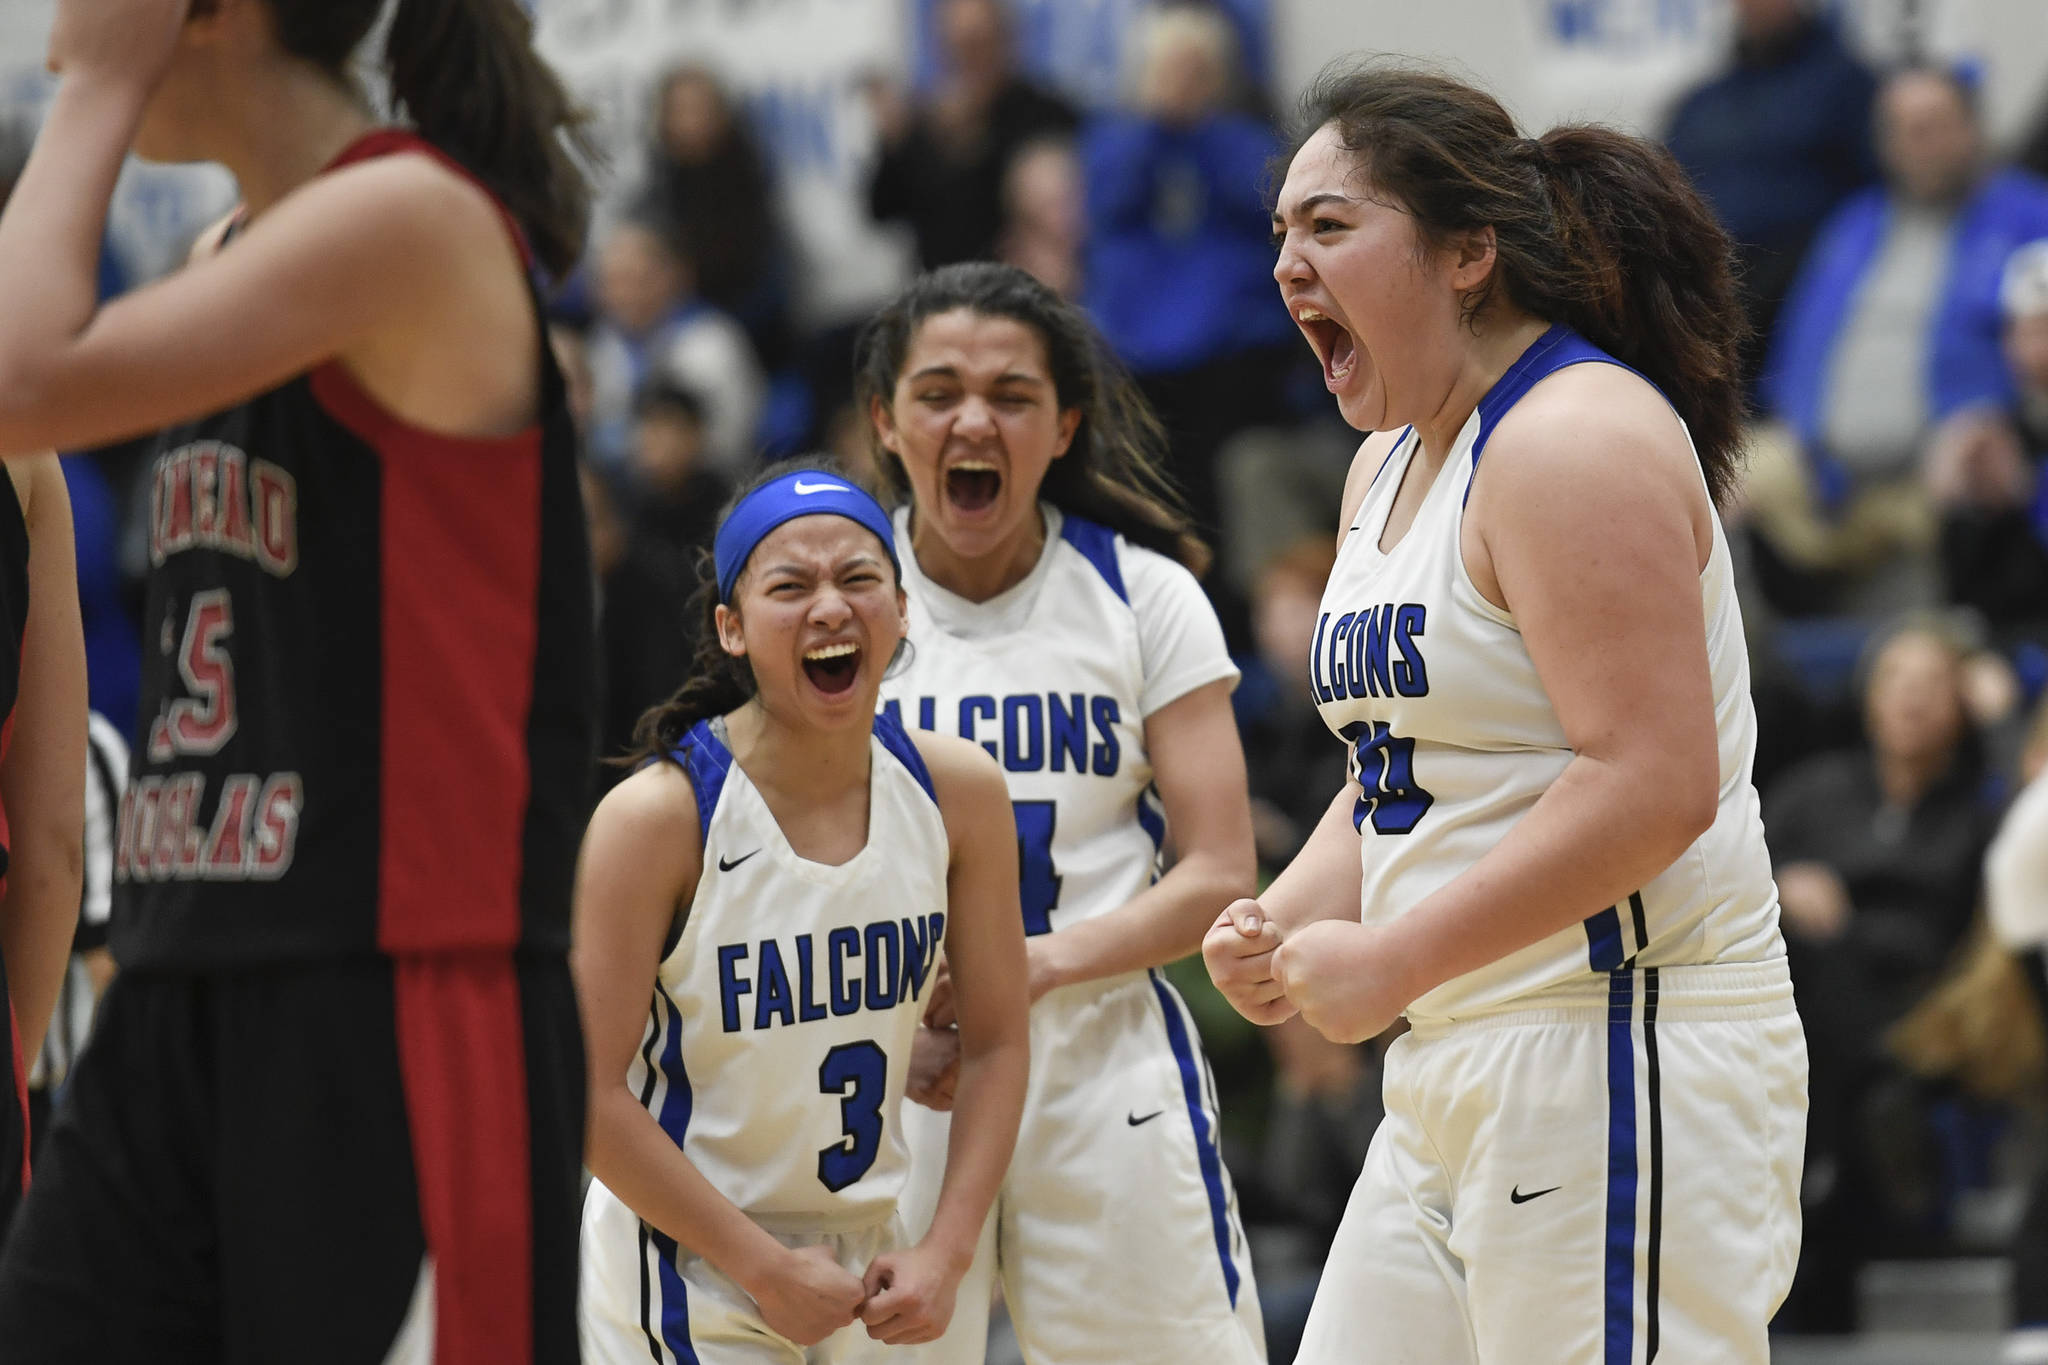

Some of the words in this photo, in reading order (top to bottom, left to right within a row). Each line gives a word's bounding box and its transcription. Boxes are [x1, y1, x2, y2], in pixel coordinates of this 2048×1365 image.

[147, 587, 239, 762] 5
[1311, 603, 1430, 705] LCONS
[818, 1039, 888, 1193] 3
